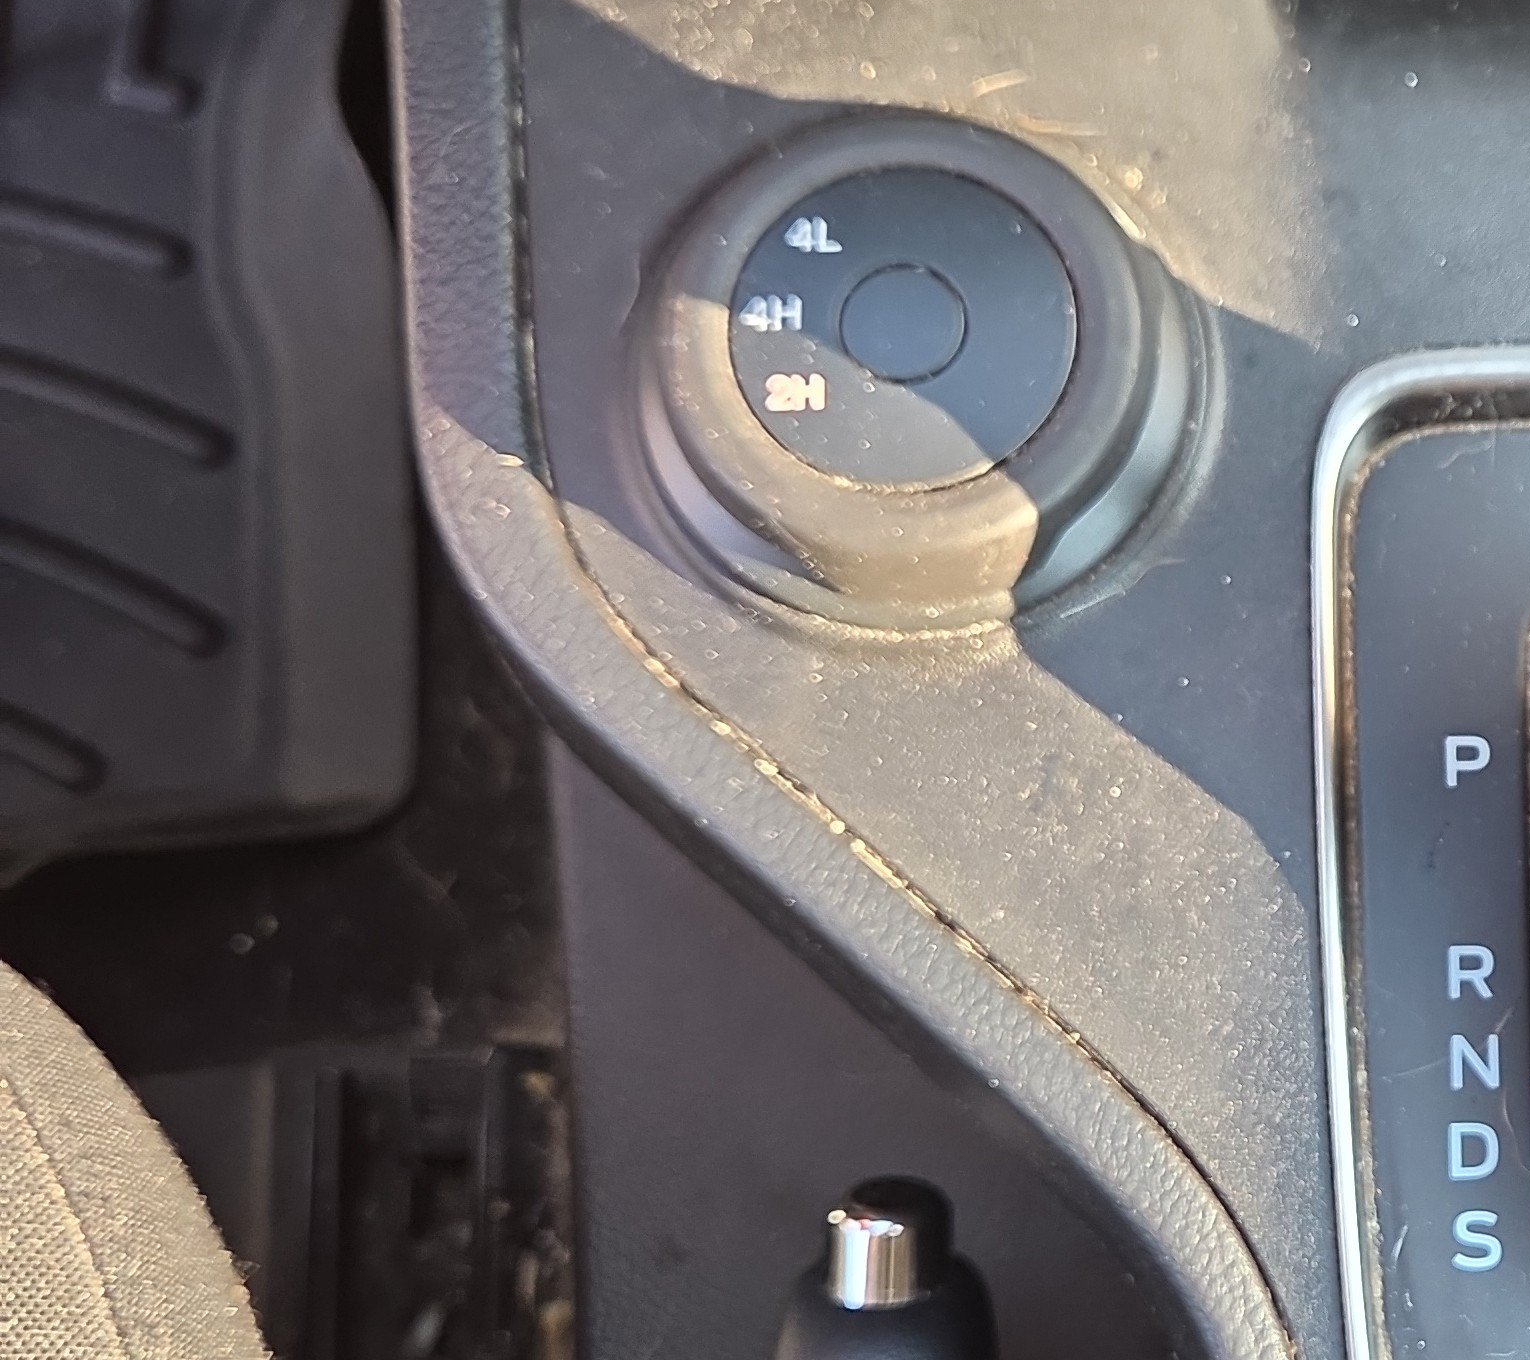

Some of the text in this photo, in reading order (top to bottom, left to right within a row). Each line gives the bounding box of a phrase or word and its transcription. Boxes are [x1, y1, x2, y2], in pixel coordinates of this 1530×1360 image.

[784, 216, 843, 254] 4L
[738, 293, 804, 332] 4H
[763, 373, 827, 412] 2H
[1444, 735, 1492, 787] P
[1447, 945, 1495, 999] R
[1450, 1034, 1500, 1090] N
[1447, 1122, 1500, 1181] D
[1451, 1210, 1503, 1272] S
